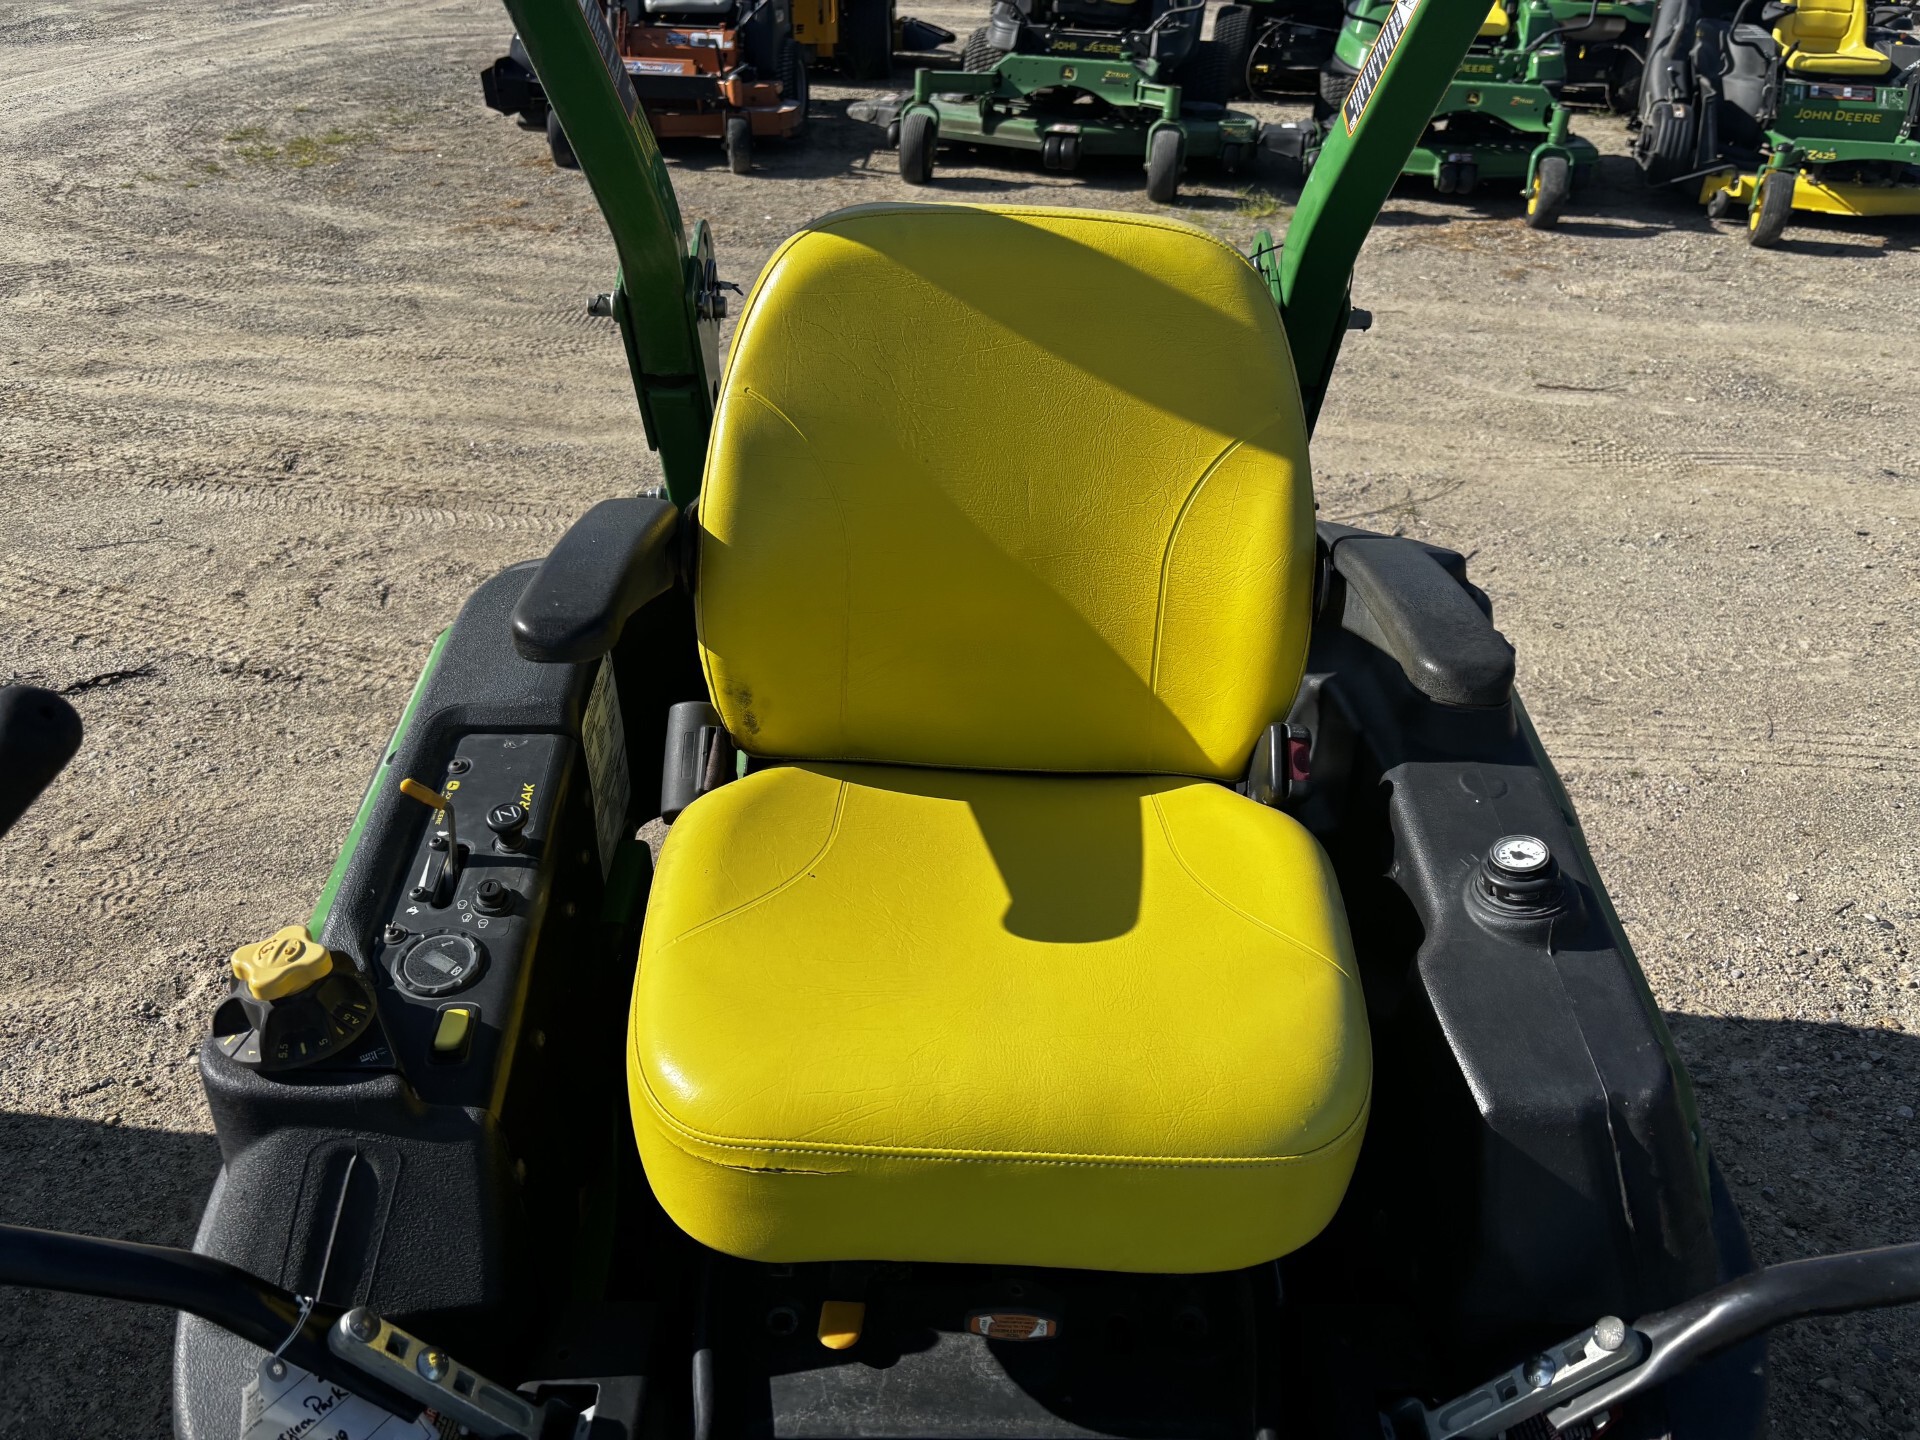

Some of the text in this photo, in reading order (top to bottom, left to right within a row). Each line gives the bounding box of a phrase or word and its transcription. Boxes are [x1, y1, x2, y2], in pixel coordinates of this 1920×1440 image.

[1794, 108, 1882, 123] JOHN DEERE
[1807, 150, 1837, 160] Z425
[343, 1013, 360, 1025] 4.5
[278, 1043, 289, 1059] 5.5
[303, 1387, 349, 1416] Park
